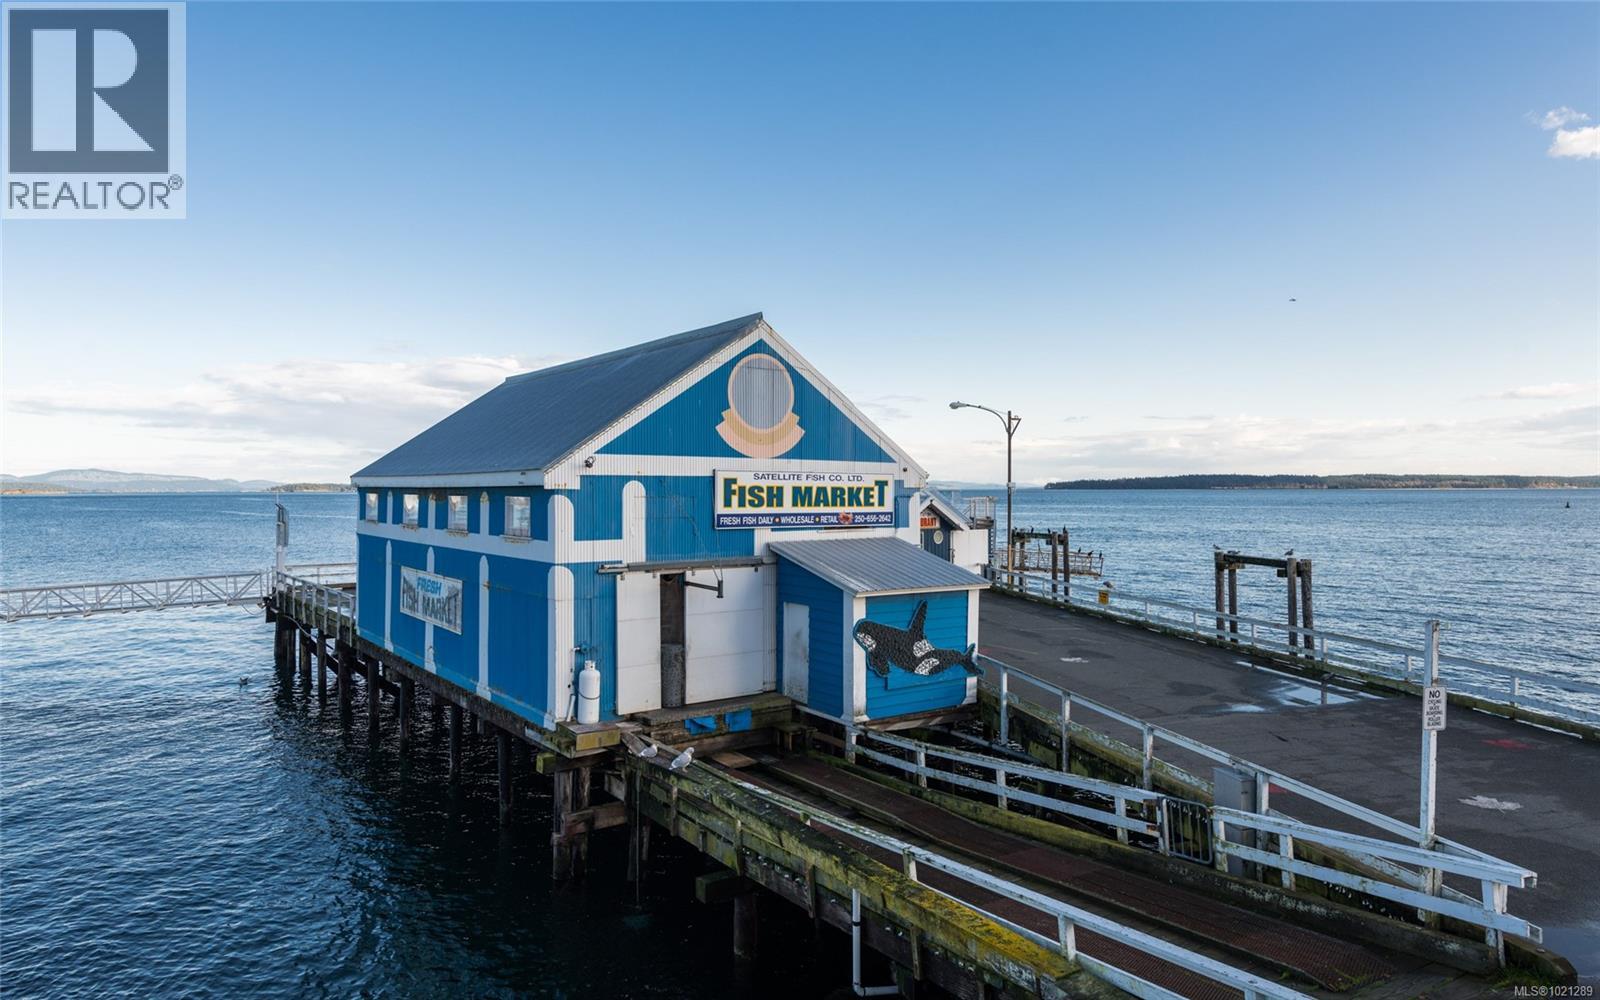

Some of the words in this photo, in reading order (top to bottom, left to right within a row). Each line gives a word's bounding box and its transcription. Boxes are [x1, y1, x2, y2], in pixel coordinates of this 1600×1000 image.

[753, 472, 803, 481] SATELLITE
[828, 474, 845, 482] CO.
[847, 475, 865, 483] LTD.
[723, 477, 784, 508] FISH
[791, 479, 889, 508] MARKET
[719, 516, 741, 525] FRESH
[742, 516, 757, 525] FISH
[758, 516, 774, 525] DAILY
[780, 515, 815, 524] WHOLESALE
[820, 515, 839, 524] RETAIL
[854, 514, 892, 523] 250-656-2642
[416, 576, 442, 597] FRESH
[402, 576, 419, 614] FISH
[1429, 690, 1441, 698] NO
